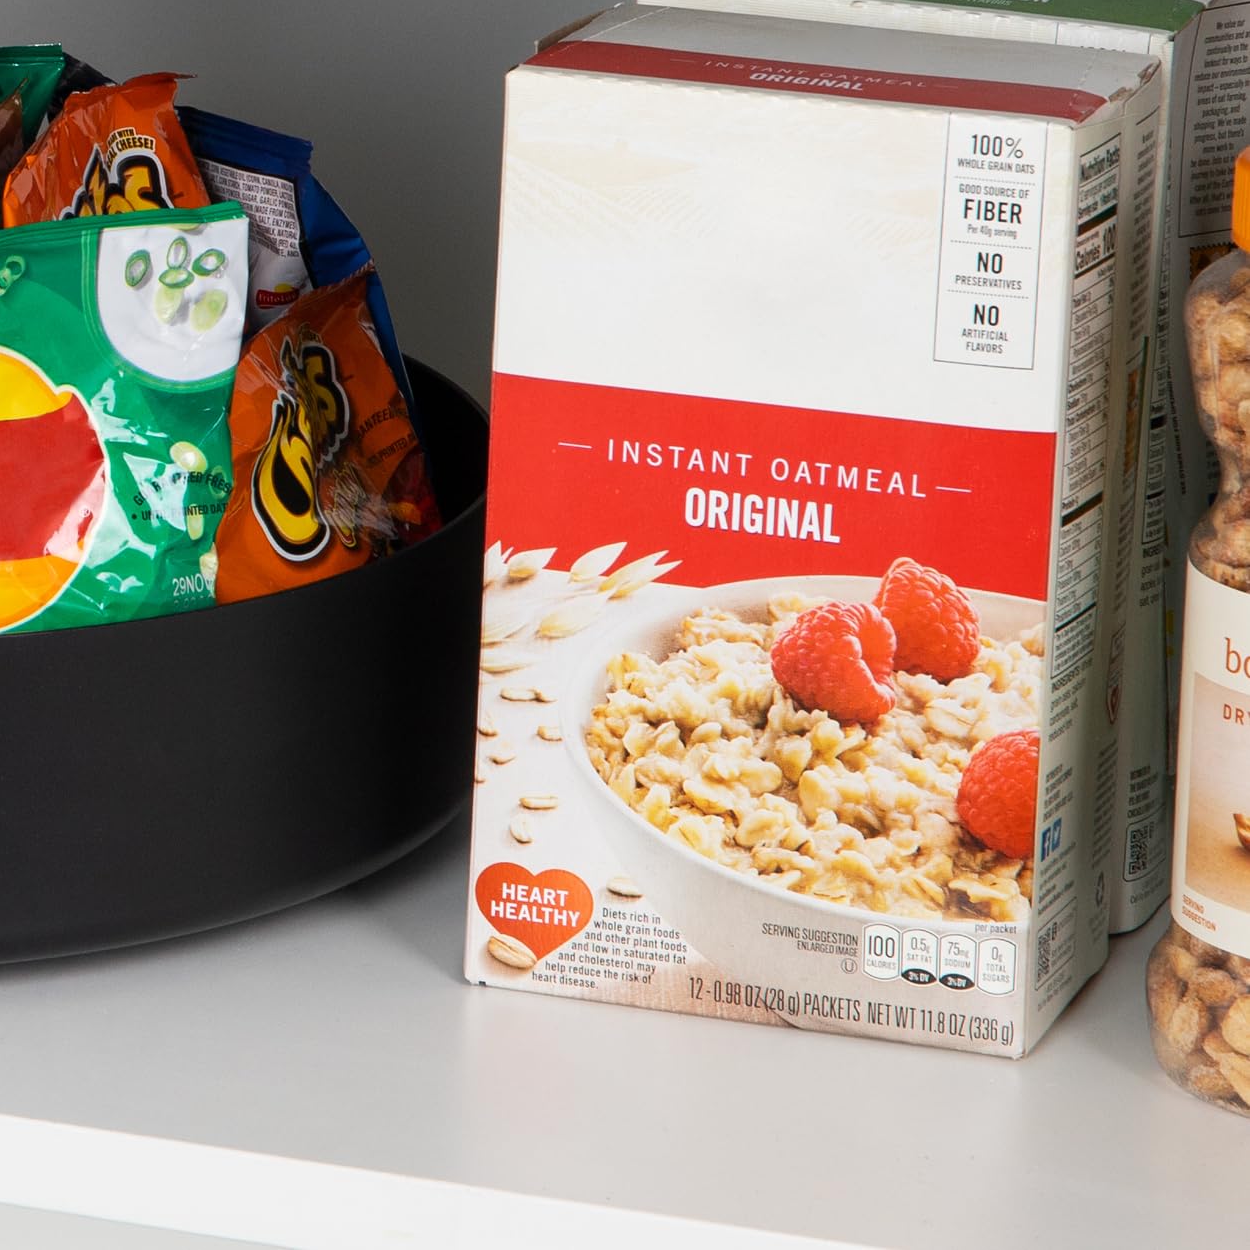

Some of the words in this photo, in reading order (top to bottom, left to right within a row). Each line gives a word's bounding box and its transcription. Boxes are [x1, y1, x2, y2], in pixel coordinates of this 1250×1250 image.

[703, 61, 805, 75] INSTANT
[819, 71, 928, 88] OATMEAL
[750, 72, 864, 91] ORIGINAL
[116, 136, 154, 152] CHEESE!
[971, 133, 1024, 159] 100%
[957, 157, 986, 170] WHOLE
[987, 160, 1013, 173] GRAIN
[1015, 163, 1035, 175] OATS
[958, 183, 982, 195] GOOD
[983, 185, 1016, 198] SOURCE
[1018, 189, 1030, 199] OF
[963, 197, 1022, 225] FIBER
[967, 223, 978, 234] Per
[994, 228, 1017, 240] serving
[977, 251, 1003, 274] NO
[954, 274, 1023, 290] PRESERVATIVES
[973, 303, 1000, 326] NO
[961, 328, 1009, 342] ARTIFICIAL
[966, 341, 1004, 354] FLAVORS
[607, 438, 752, 477] INSTANT
[770, 457, 926, 498] OATMEAL
[685, 487, 840, 543] ORIGINAL
[1223, 703, 1250, 726] DR
[501, 882, 569, 907] HEART
[490, 900, 580, 927] HEALTHY
[602, 907, 627, 921] Diets
[630, 910, 648, 923] rich
[651, 913, 661, 925] in
[593, 919, 622, 932] whole
[625, 923, 650, 936] grain
[653, 925, 680, 940] foods
[761, 922, 800, 939] SERVING
[801, 928, 859, 946] SUGGESTION
[975, 924, 988, 935] per
[990, 924, 1017, 936] packet
[571, 940, 589, 951] and
[591, 942, 609, 954] low
[612, 945, 621, 956] in
[623, 947, 670, 963] saturated
[673, 953, 687, 965] fat
[584, 930, 603, 941] and
[605, 932, 631, 945] other
[633, 934, 658, 950] plant
[660, 938, 687, 953] foods
[797, 940, 835, 955] ENLARGED
[835, 945, 859, 958] IMAGE
[867, 935, 896, 958] 100
[545, 960, 566, 974] help
[568, 963, 601, 977] reduce
[603, 968, 619, 979] the
[621, 971, 639, 982] risk
[641, 973, 652, 984] of
[558, 950, 576, 962] and
[578, 953, 634, 970] cholesterol
[636, 961, 656, 975] may
[866, 958, 896, 971] CALORIES
[906, 951, 920, 962] SAT
[920, 953, 933, 964] FAT
[943, 956, 971, 969] SODIUM
[985, 962, 1007, 974] TOTAL
[531, 970, 557, 984] heart
[559, 974, 598, 989] disease.
[982, 971, 1011, 984] SUGARS
[688, 976, 703, 1000] 12
[713, 982, 741, 1006] 0.98
[744, 985, 762, 1009] OZ
[763, 986, 785, 1013] (28
[787, 991, 801, 1017] g)
[803, 993, 861, 1022] PACKETS
[867, 1001, 892, 1026] NET
[894, 1005, 917, 1030] WT
[920, 1009, 945, 1034] 11.8
[949, 1012, 966, 1037] OZ
[968, 1014, 999, 1042] (336
[1000, 1020, 1015, 1046] g)
